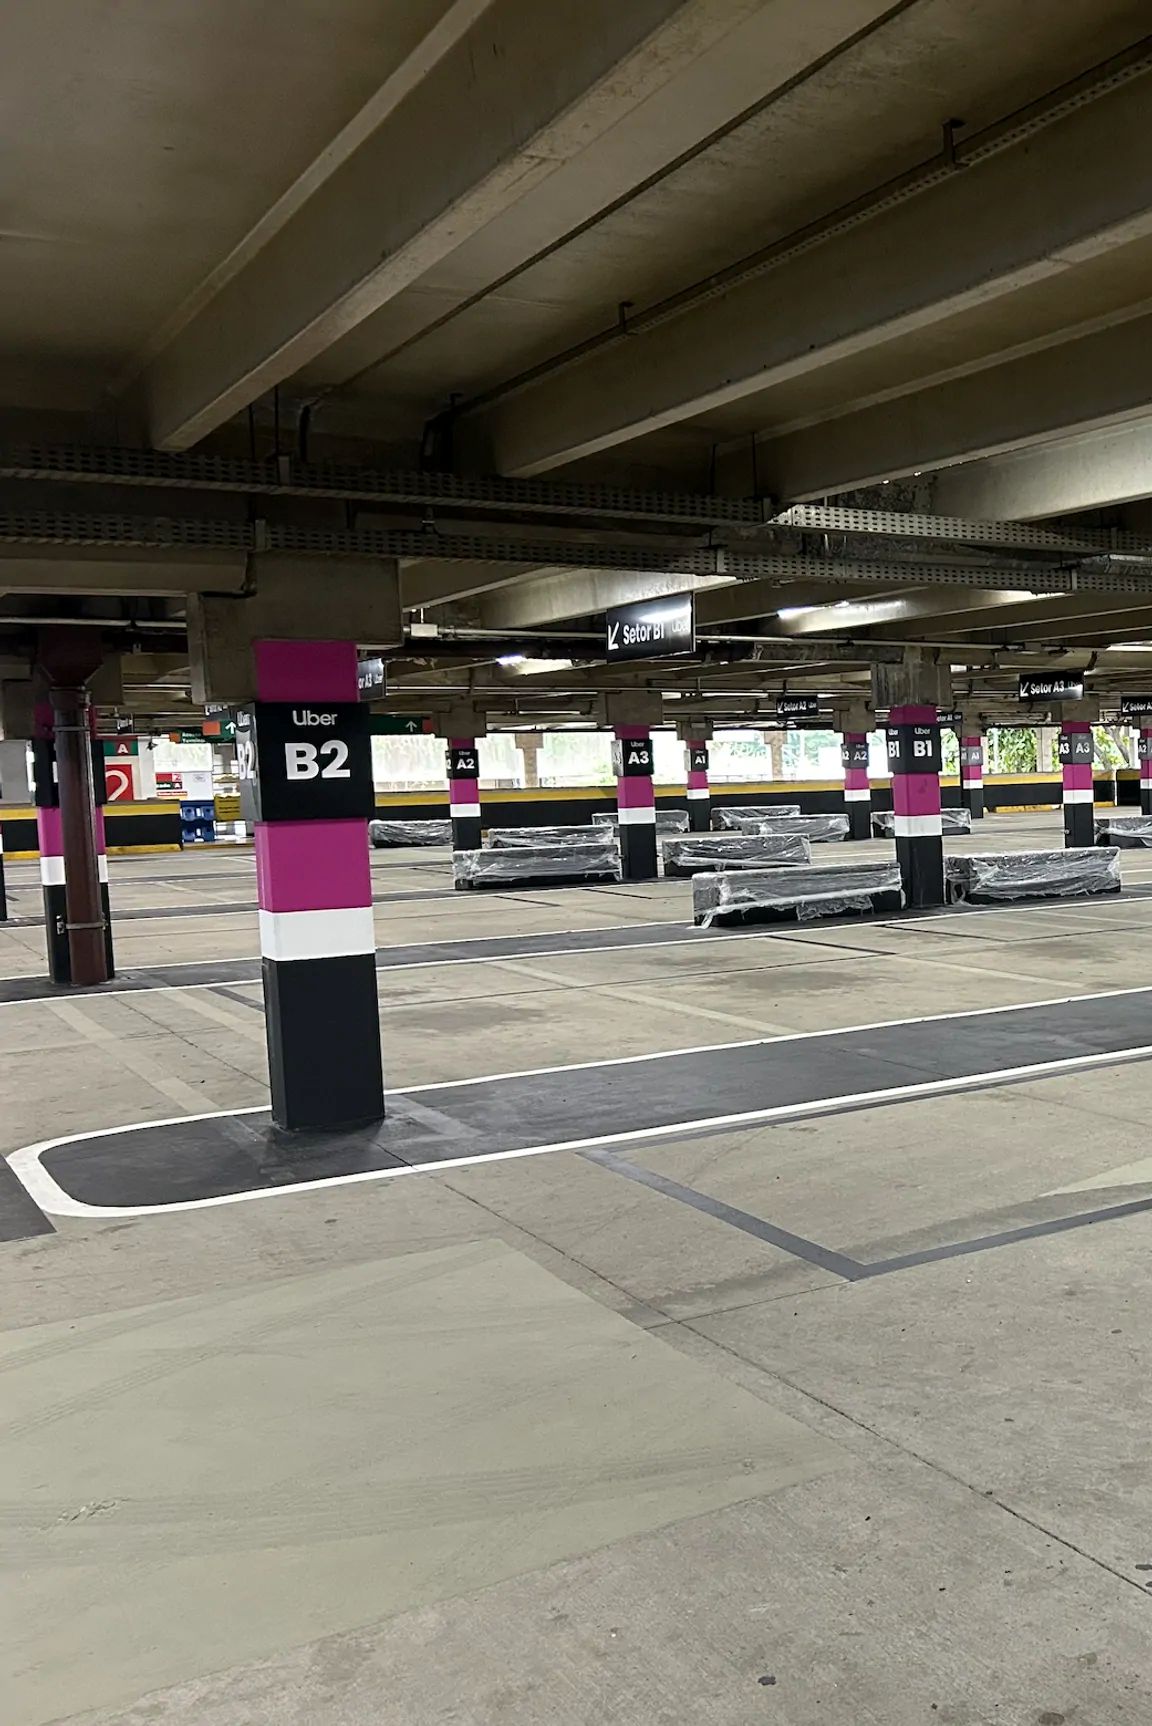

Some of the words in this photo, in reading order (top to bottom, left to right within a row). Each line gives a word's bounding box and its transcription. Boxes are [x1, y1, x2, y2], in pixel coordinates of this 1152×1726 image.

[623, 623, 652, 645] Setor
[653, 622, 665, 640] B1
[1030, 682, 1053, 696] Setor
[1053, 680, 1065, 693] A3
[784, 702, 799, 712] Setor
[800, 701, 807, 710] A2
[1130, 702, 1146, 712] Setor
[292, 710, 338, 726] Uber
[914, 727, 931, 735] Uber
[117, 743, 129, 754] A
[888, 740, 900, 757] B1
[914, 740, 933, 757] B1
[1060, 743, 1070, 755] A3
[1076, 742, 1090, 754] A3
[237, 740, 256, 780] B2
[284, 739, 351, 780] B2
[628, 750, 650, 765] A3
[695, 755, 706, 764] A1
[854, 751, 867, 760] A2
[457, 758, 475, 770] A2
